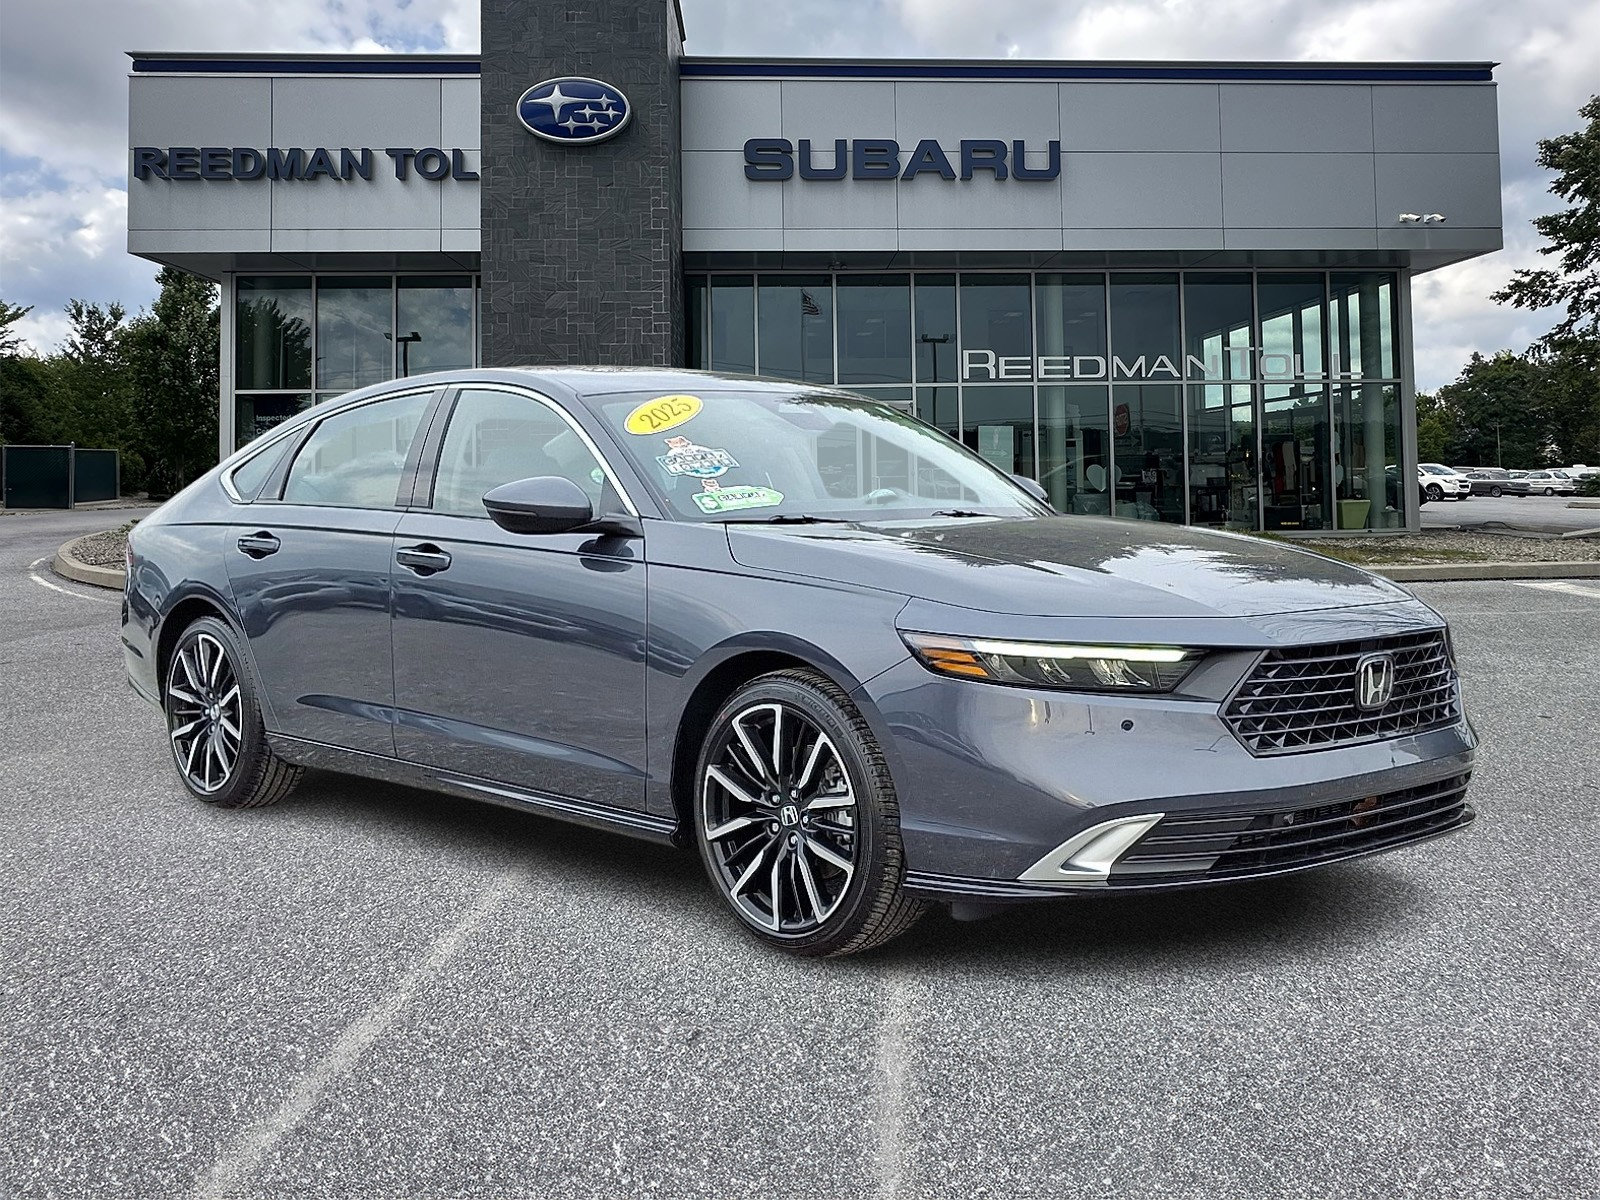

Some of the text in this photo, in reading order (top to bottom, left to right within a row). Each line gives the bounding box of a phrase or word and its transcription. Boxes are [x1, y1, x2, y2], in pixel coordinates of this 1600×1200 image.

[133, 147, 373, 181] REEDMAN
[743, 138, 1061, 181] SUBARU
[962, 346, 1364, 379] REEDMAN TOLL
[256, 414, 292, 423] Inspected
[639, 398, 692, 429] 2025
